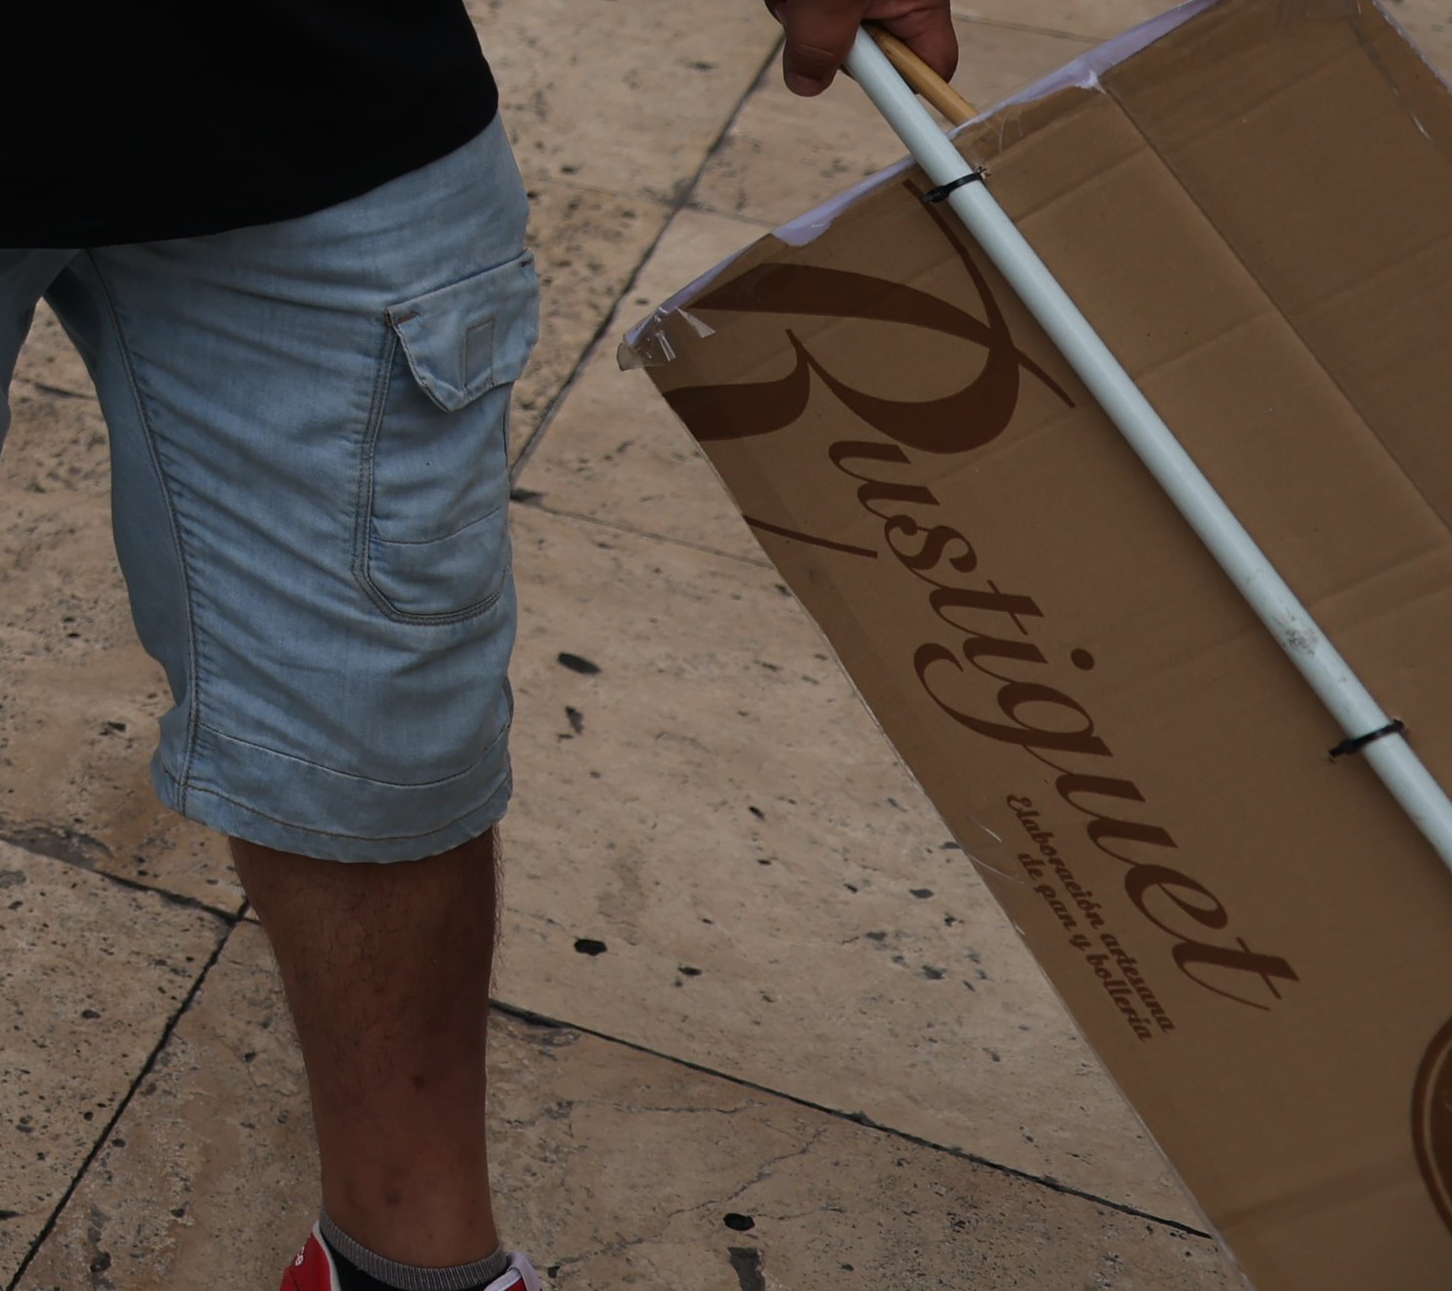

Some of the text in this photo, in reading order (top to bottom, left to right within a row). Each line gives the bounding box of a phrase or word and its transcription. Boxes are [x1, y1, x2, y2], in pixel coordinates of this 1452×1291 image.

[663, 179, 1300, 1011] Rustiguet
[1006, 794, 1176, 1033] Elaboración artesana
[1018, 852, 1153, 1043] de pan y bollería
